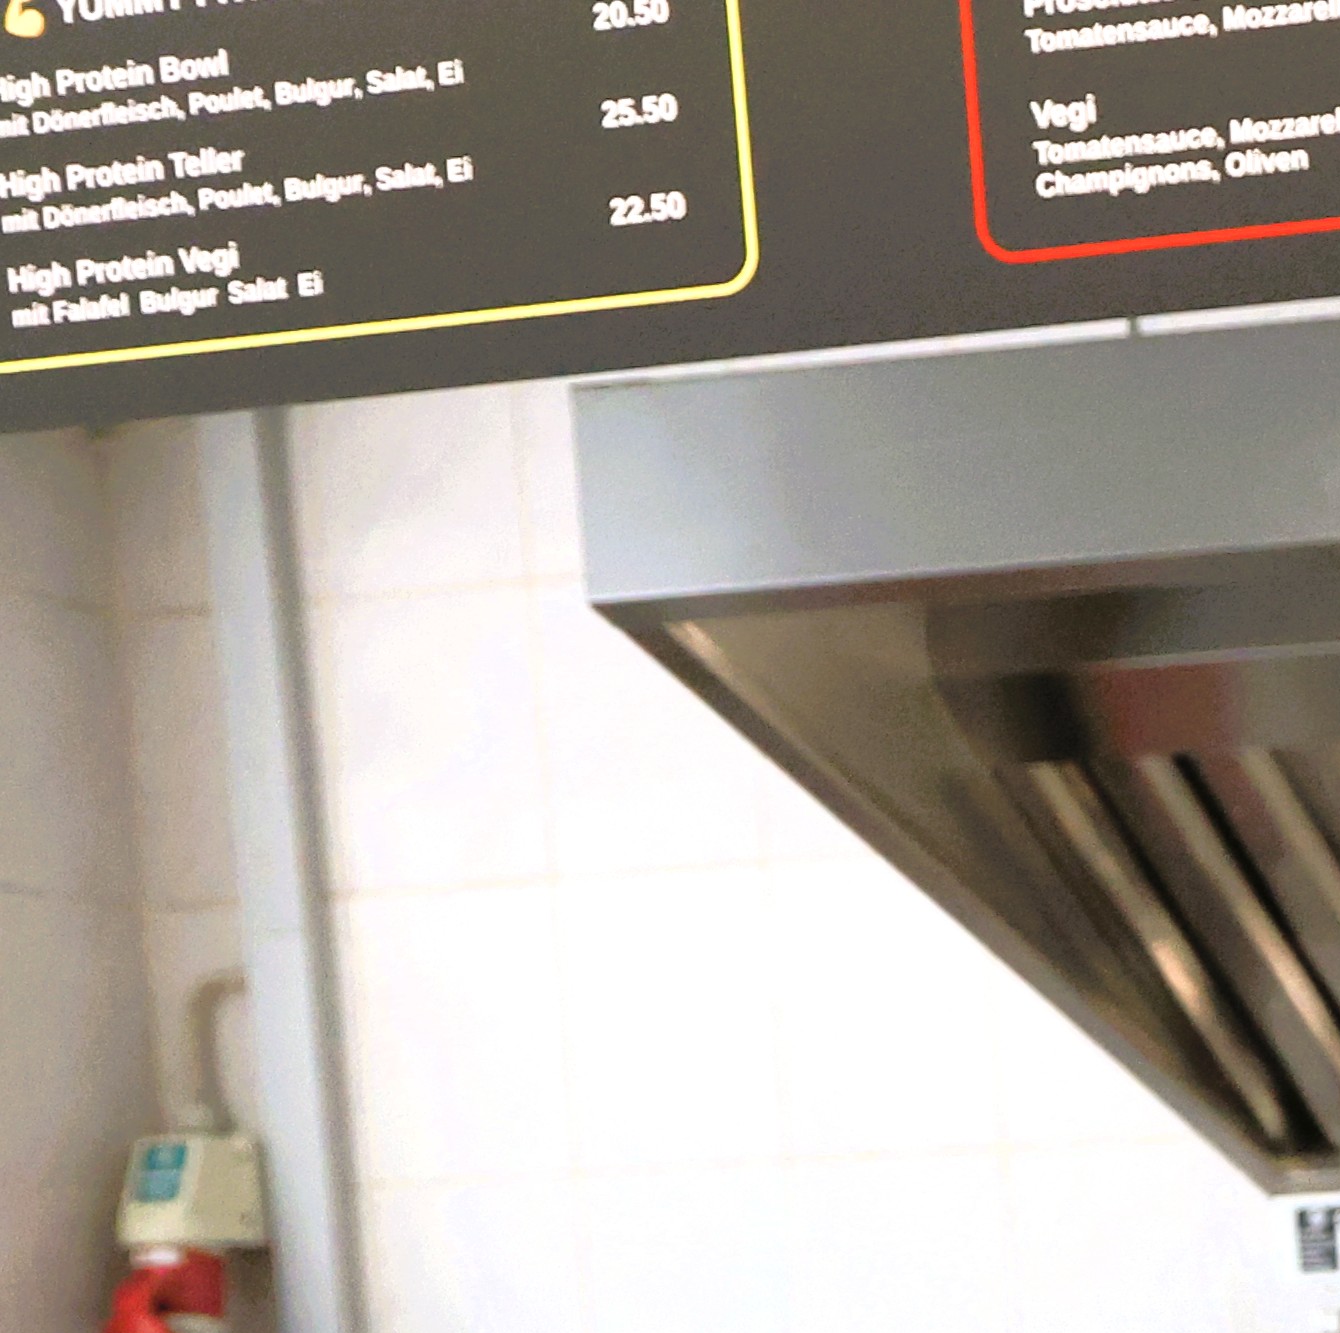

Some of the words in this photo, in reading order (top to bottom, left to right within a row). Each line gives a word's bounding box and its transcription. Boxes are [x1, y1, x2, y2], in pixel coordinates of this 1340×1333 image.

[592, 0, 670, 31] 20.50
[1024, 13, 1218, 54] Tomatensauce,
[0, 72, 51, 108] igh
[55, 60, 155, 96] Protein
[158, 48, 230, 84] Bowl
[32, 95, 187, 132] Dönerfleisch,
[188, 85, 272, 116] Poulet,
[274, 76, 364, 106] Bulgur,
[365, 65, 435, 95] Salat,
[437, 58, 465, 87] Ei
[600, 93, 679, 129] 25.50
[1029, 92, 1097, 132] Vegi
[1032, 125, 1225, 166] Tomatensauce,
[0, 166, 62, 203] High
[65, 155, 165, 191] Protein
[168, 147, 245, 179] Teller
[1, 207, 41, 234] mit
[42, 190, 196, 230] Dönerfleisch,
[197, 181, 282, 212] Poulet,
[283, 172, 373, 203] Bulgur,
[375, 162, 444, 192] Salat,
[446, 155, 474, 183] Ei
[1035, 156, 1222, 198] Champignons,
[1224, 148, 1310, 178] Oliven
[609, 190, 688, 227] 22.50
[7, 261, 72, 297] High
[75, 250, 175, 286] Protein
[177, 240, 240, 277] Vegi
[12, 302, 51, 328] mit
[52, 292, 131, 324] Falafel
[139, 286, 219, 316] Bulgur
[227, 276, 290, 305] Salat
[298, 270, 325, 297] Ei
